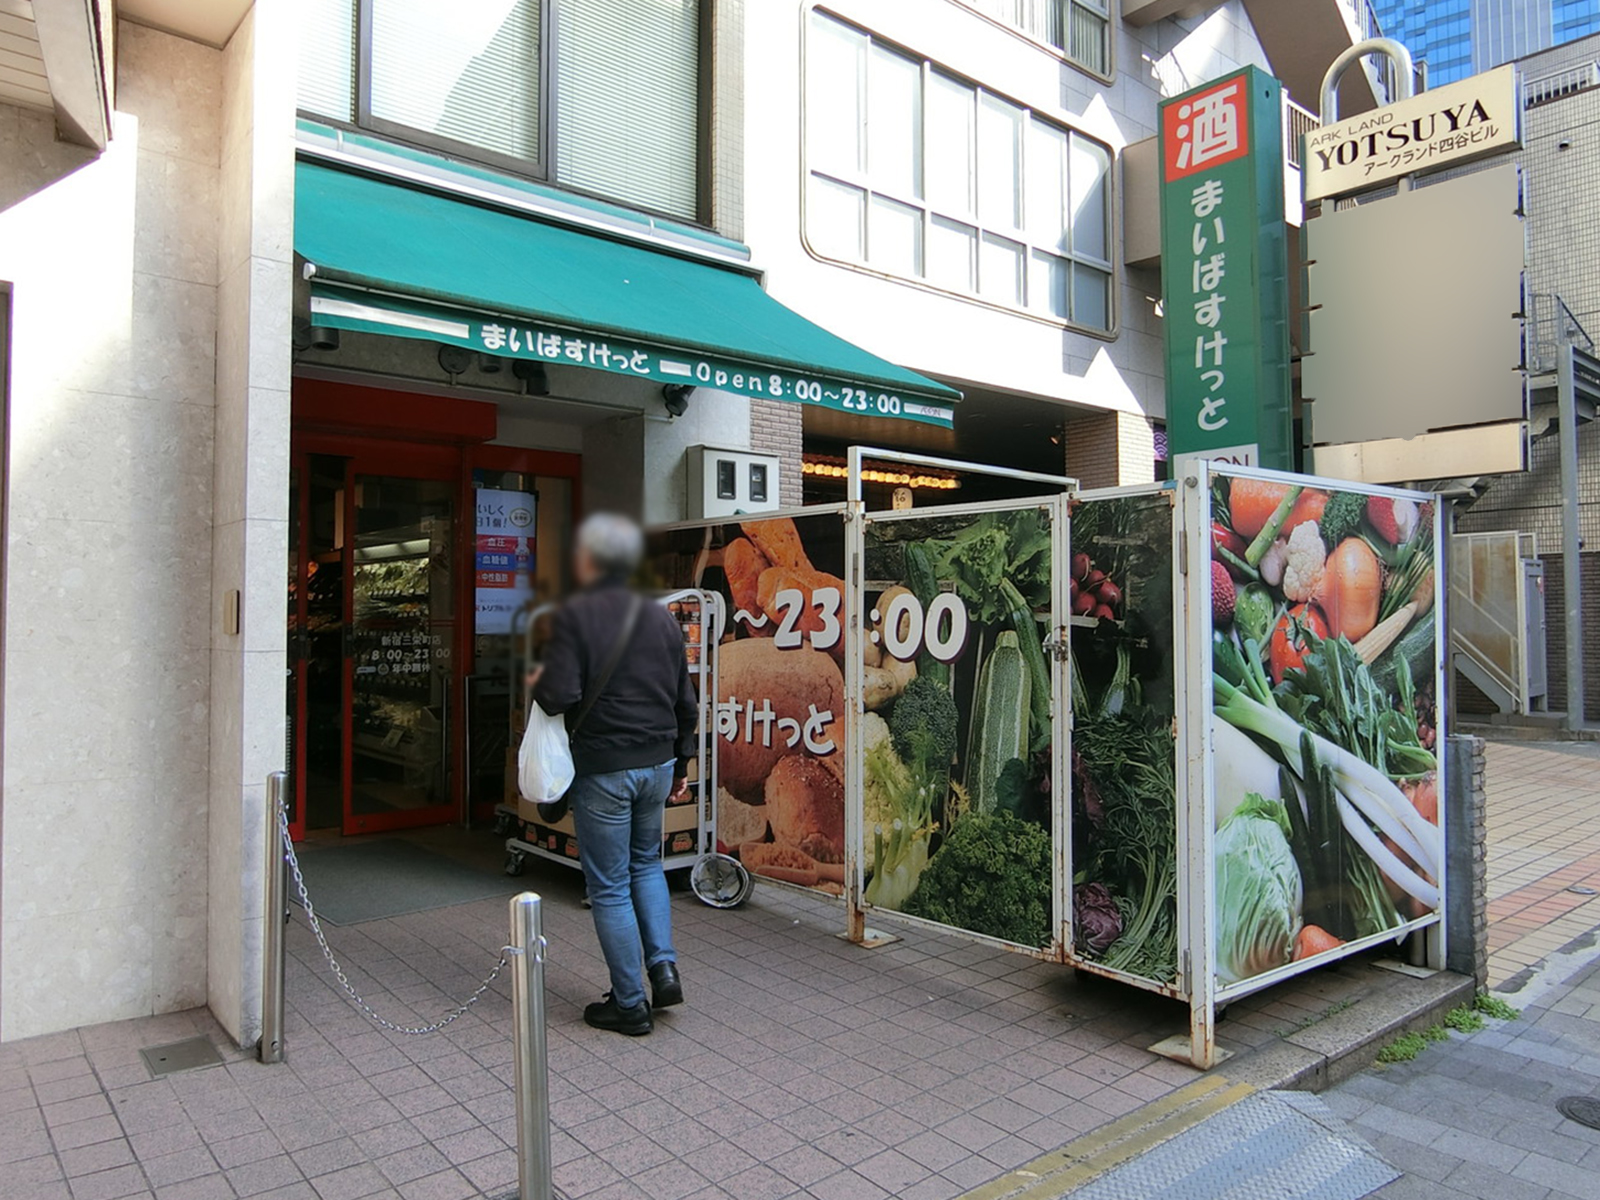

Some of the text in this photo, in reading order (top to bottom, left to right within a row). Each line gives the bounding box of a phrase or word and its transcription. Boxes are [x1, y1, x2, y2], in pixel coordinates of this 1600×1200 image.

[1176, 83, 1238, 170] 酒
[1310, 113, 1394, 148] ARK LAND
[1315, 98, 1492, 172] YOTSUYA
[1364, 124, 1500, 177] アークランド四谷ビル
[1190, 180, 1229, 431] まいばすけっと
[481, 324, 651, 374] まいばすけっと
